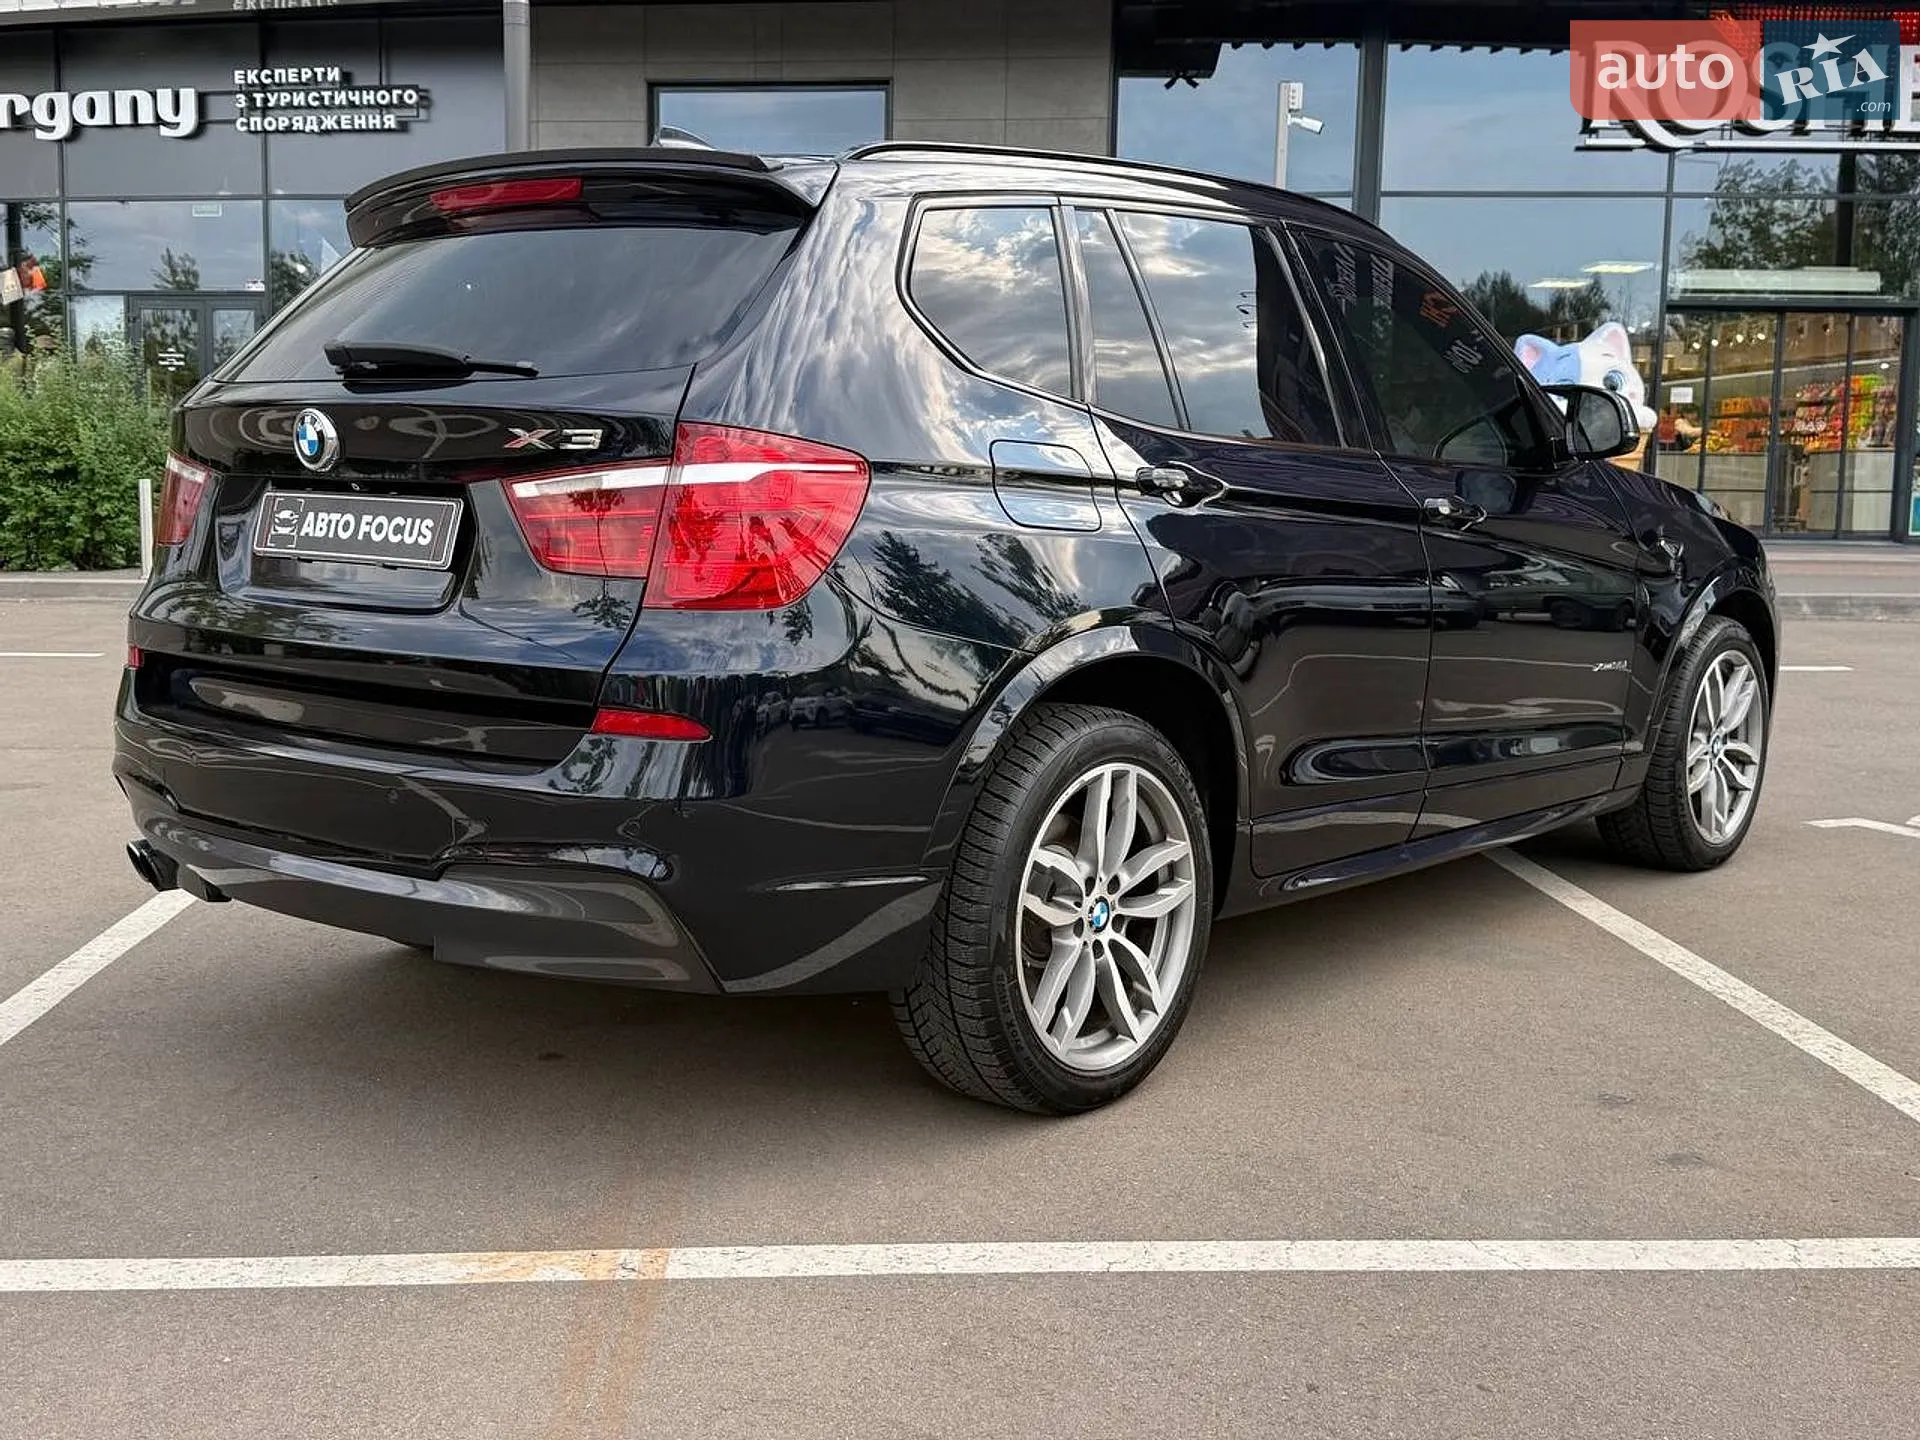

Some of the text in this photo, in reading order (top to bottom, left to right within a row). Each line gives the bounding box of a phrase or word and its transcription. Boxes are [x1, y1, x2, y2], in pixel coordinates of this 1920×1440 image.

[234, 67, 340, 85] ЕКСПЕРТИ
[252, 89, 418, 108] ТУРИСТИЧНОГО
[0, 88, 198, 140] rgany
[235, 114, 397, 132] СПОРЯДЖЕННЯ
[504, 428, 602, 449] X3
[300, 511, 435, 546] АВТО FOCUS
